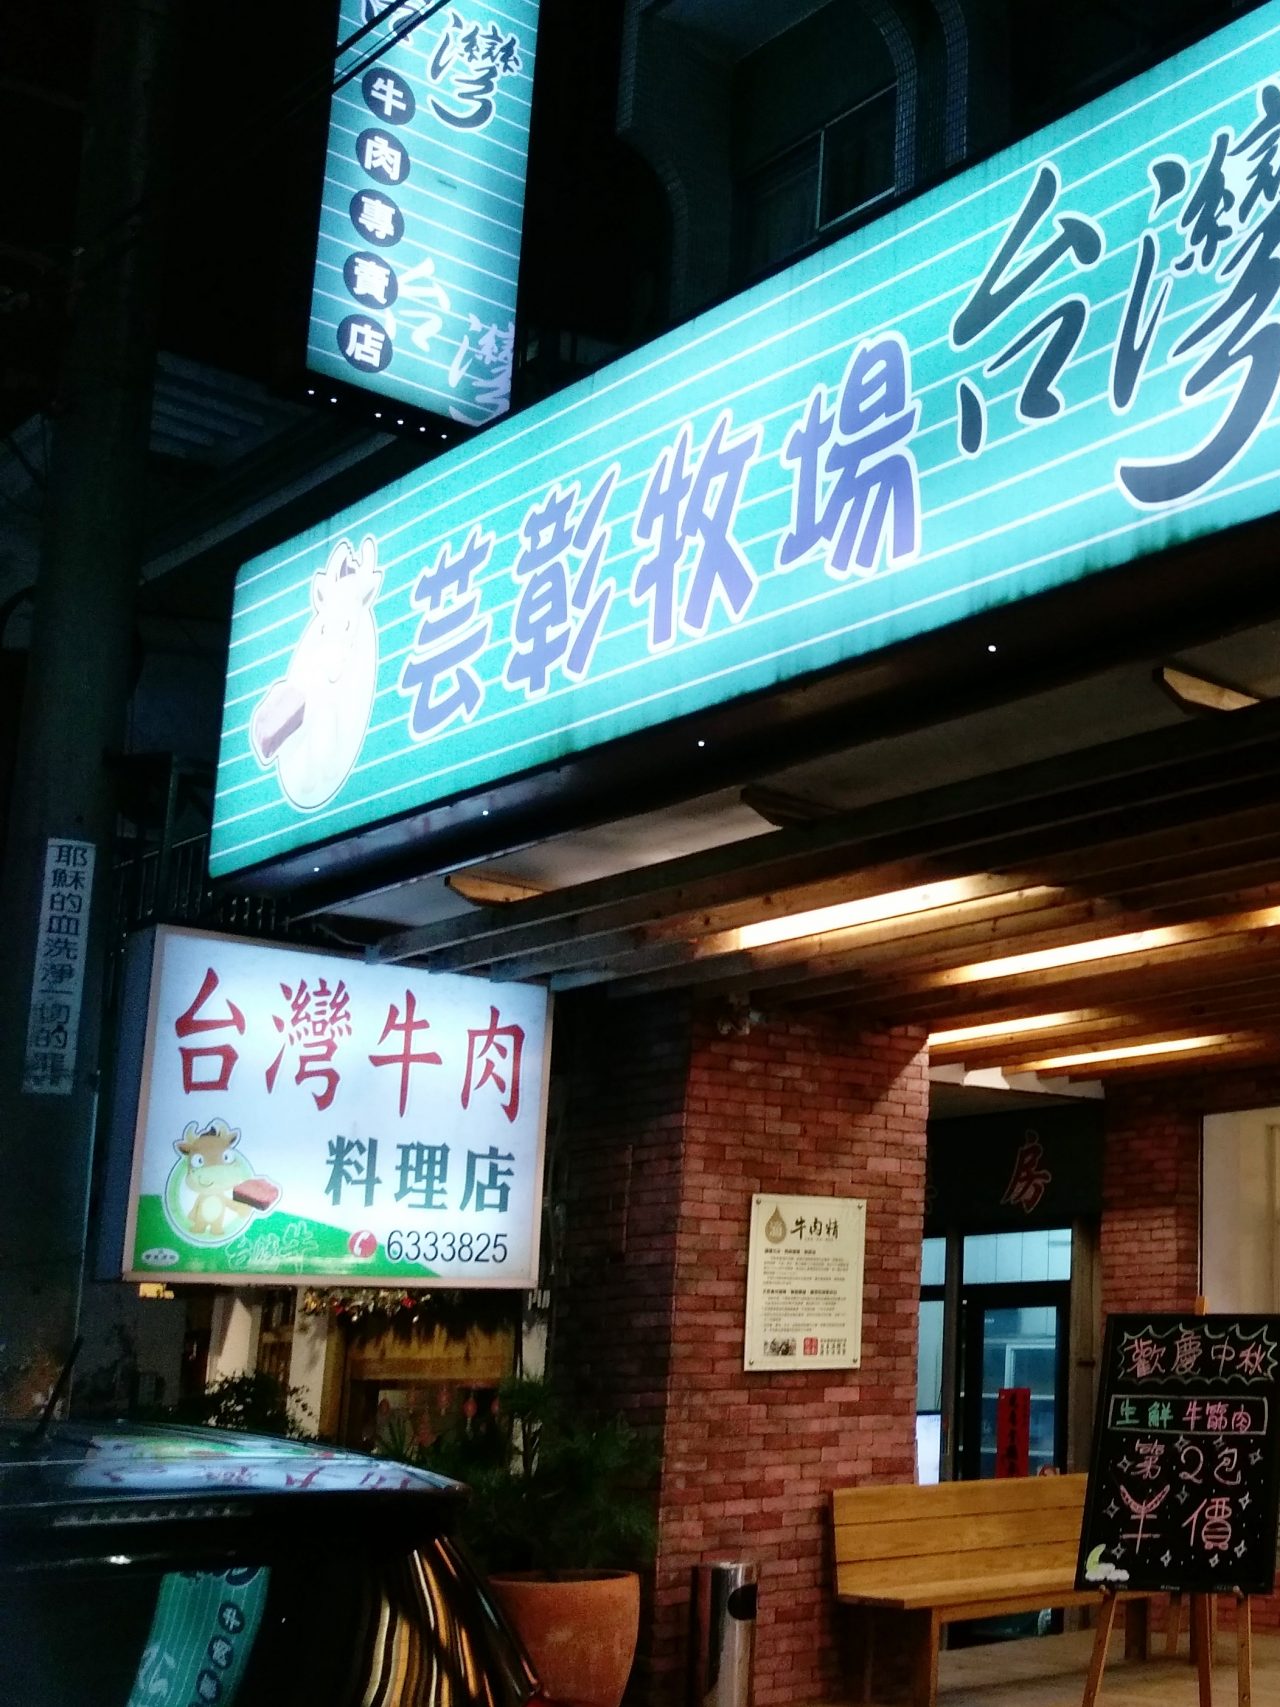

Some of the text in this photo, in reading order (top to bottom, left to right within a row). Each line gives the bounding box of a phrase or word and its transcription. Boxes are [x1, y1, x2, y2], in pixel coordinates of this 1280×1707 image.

[341, 72, 411, 370] 牛肉專賣店
[403, 334, 917, 738] 芸彰牧場
[175, 967, 526, 1123] 台灣牛肉
[324, 1135, 516, 1213] 料理店
[386, 1230, 509, 1263] 6333825
[790, 1214, 839, 1240] 牛肉精
[1124, 1330, 1267, 1377] 歡慶中秋
